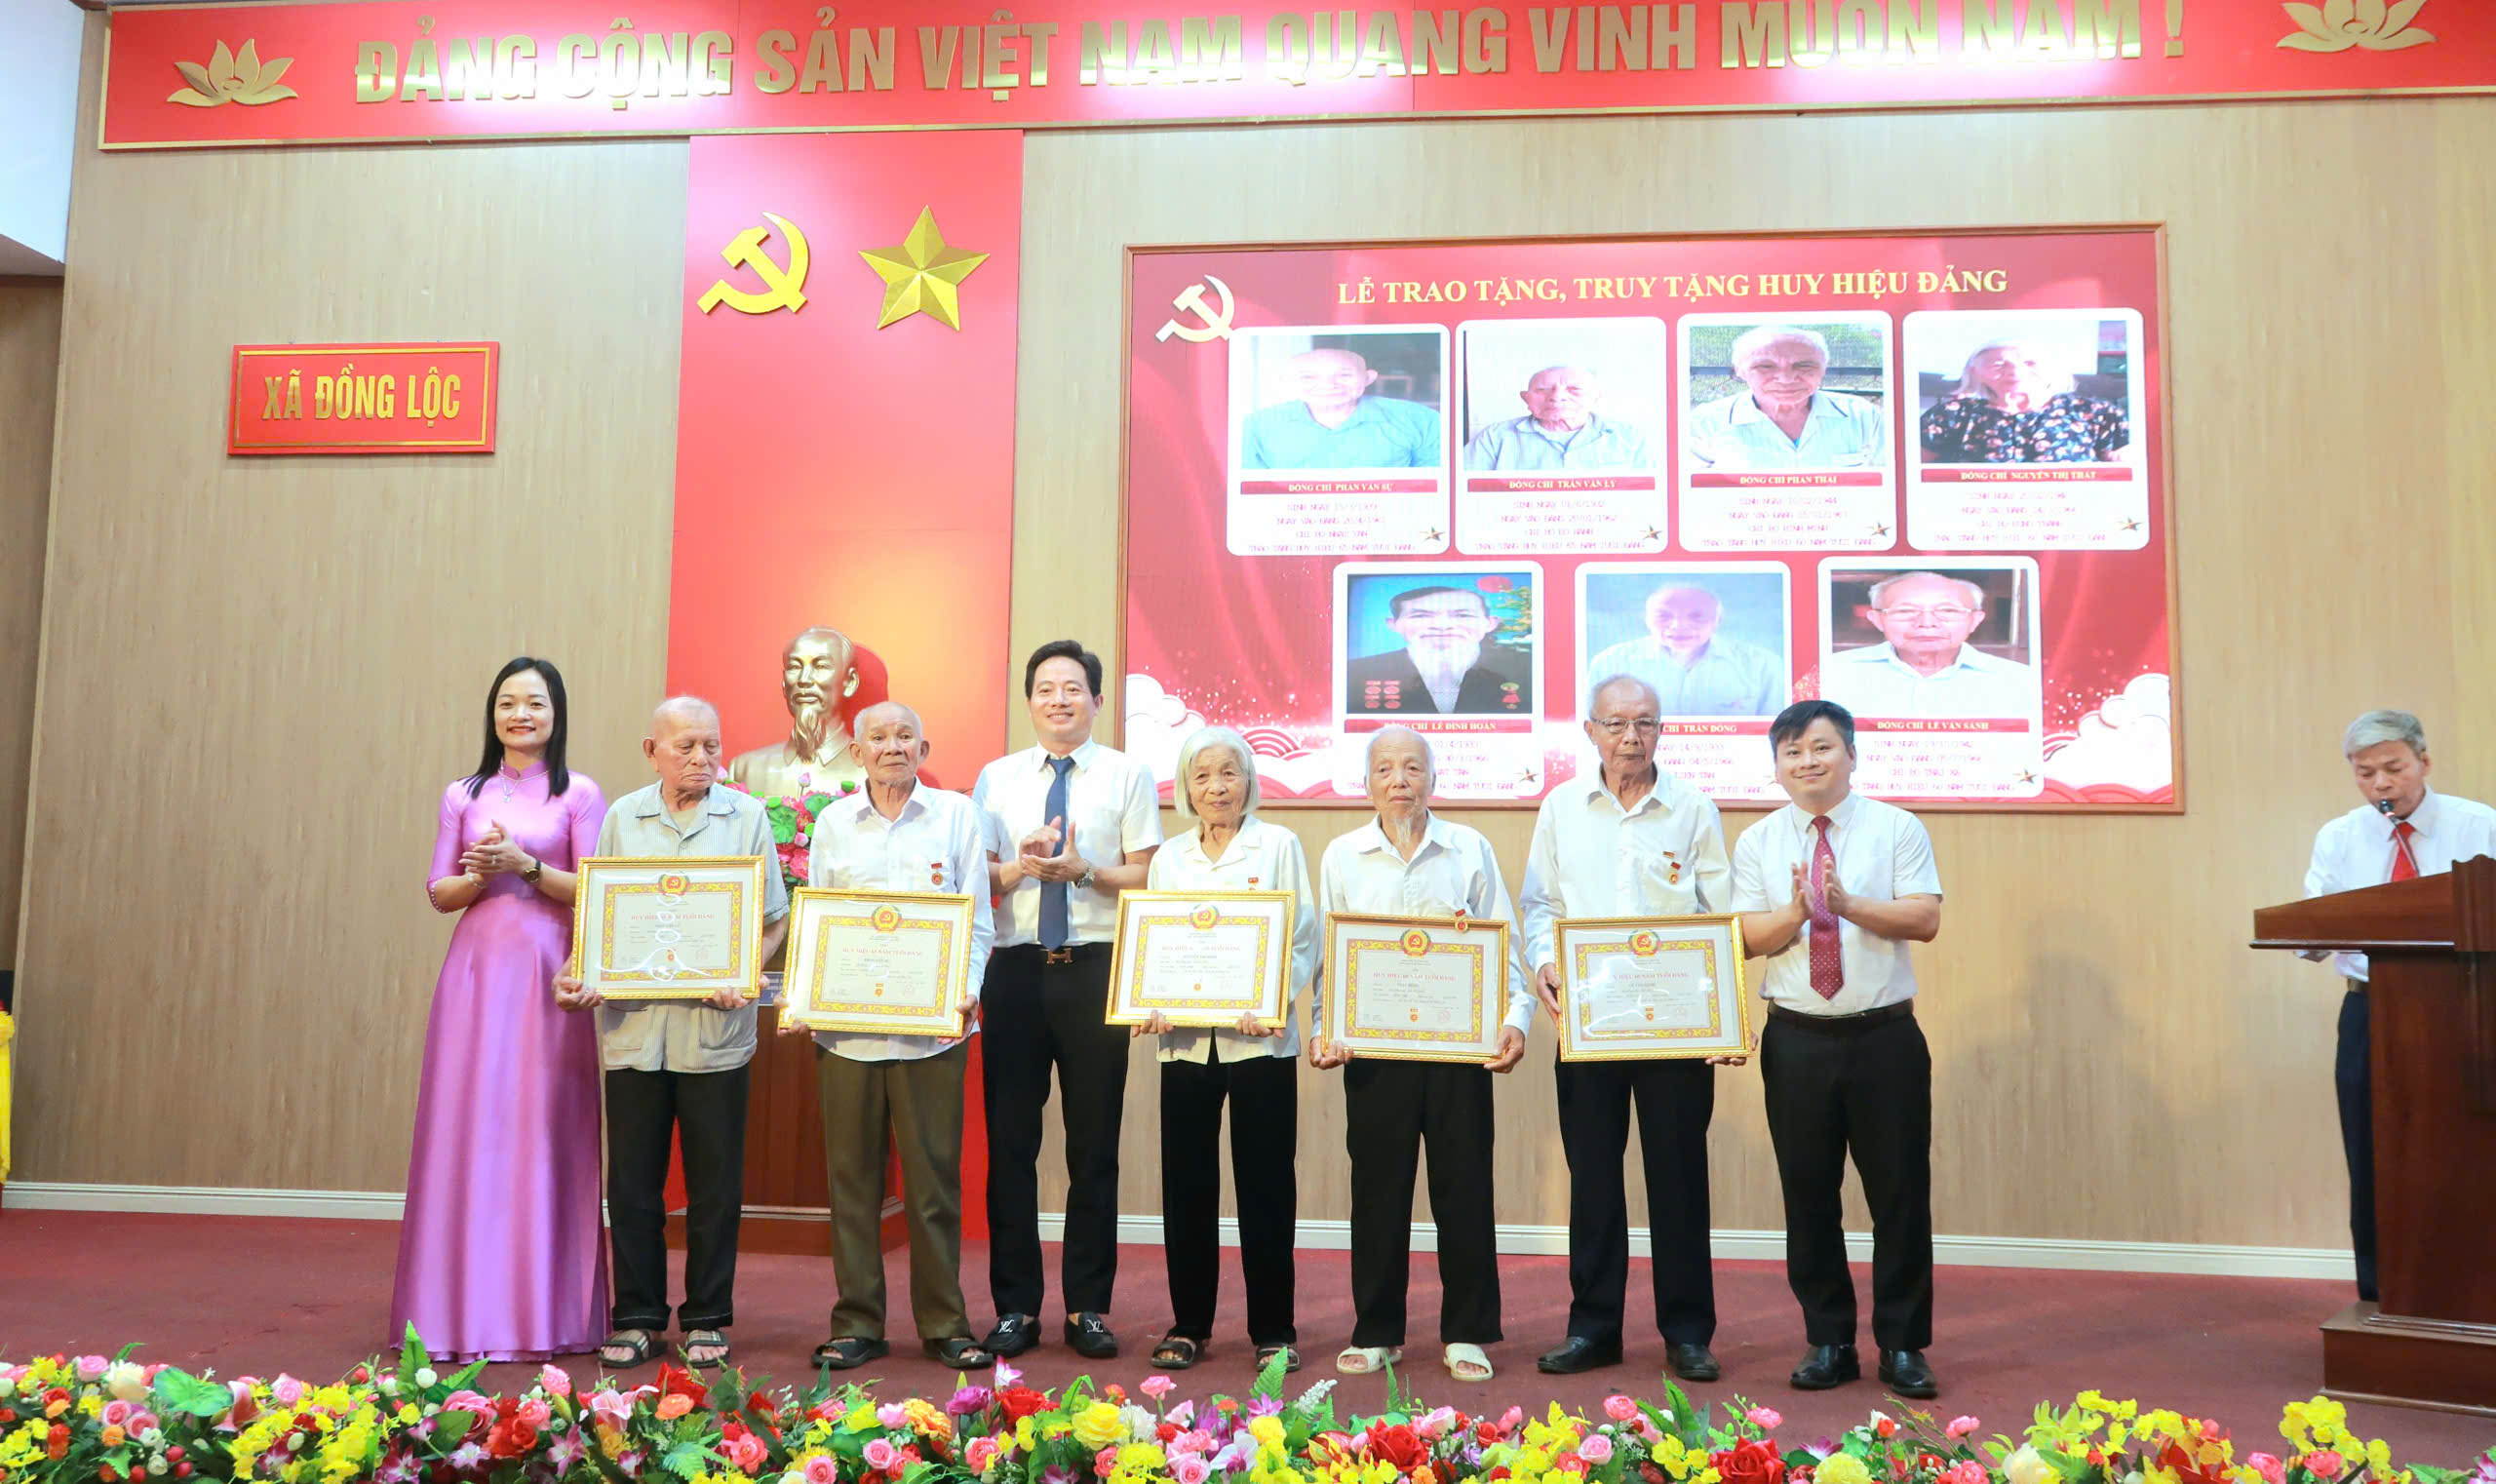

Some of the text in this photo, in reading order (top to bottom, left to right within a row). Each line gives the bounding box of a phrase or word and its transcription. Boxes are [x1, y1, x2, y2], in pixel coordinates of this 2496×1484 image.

[355, 15, 537, 103] ĐẢNG
[554, 18, 733, 110] CỘNG
[755, 6, 896, 94] SẢN
[917, 9, 1059, 101] VIỆT
[1080, 15, 1243, 86] NAM
[1265, 7, 1507, 86] QUANG
[1529, 4, 1696, 72] VINH
[1338, 264, 2009, 307] LỄ TRAO TẶNG, TRUY TẶNG HUY HIỆU ĐẢNG
[261, 363, 461, 428] XÃ ĐỒNG LỘC
